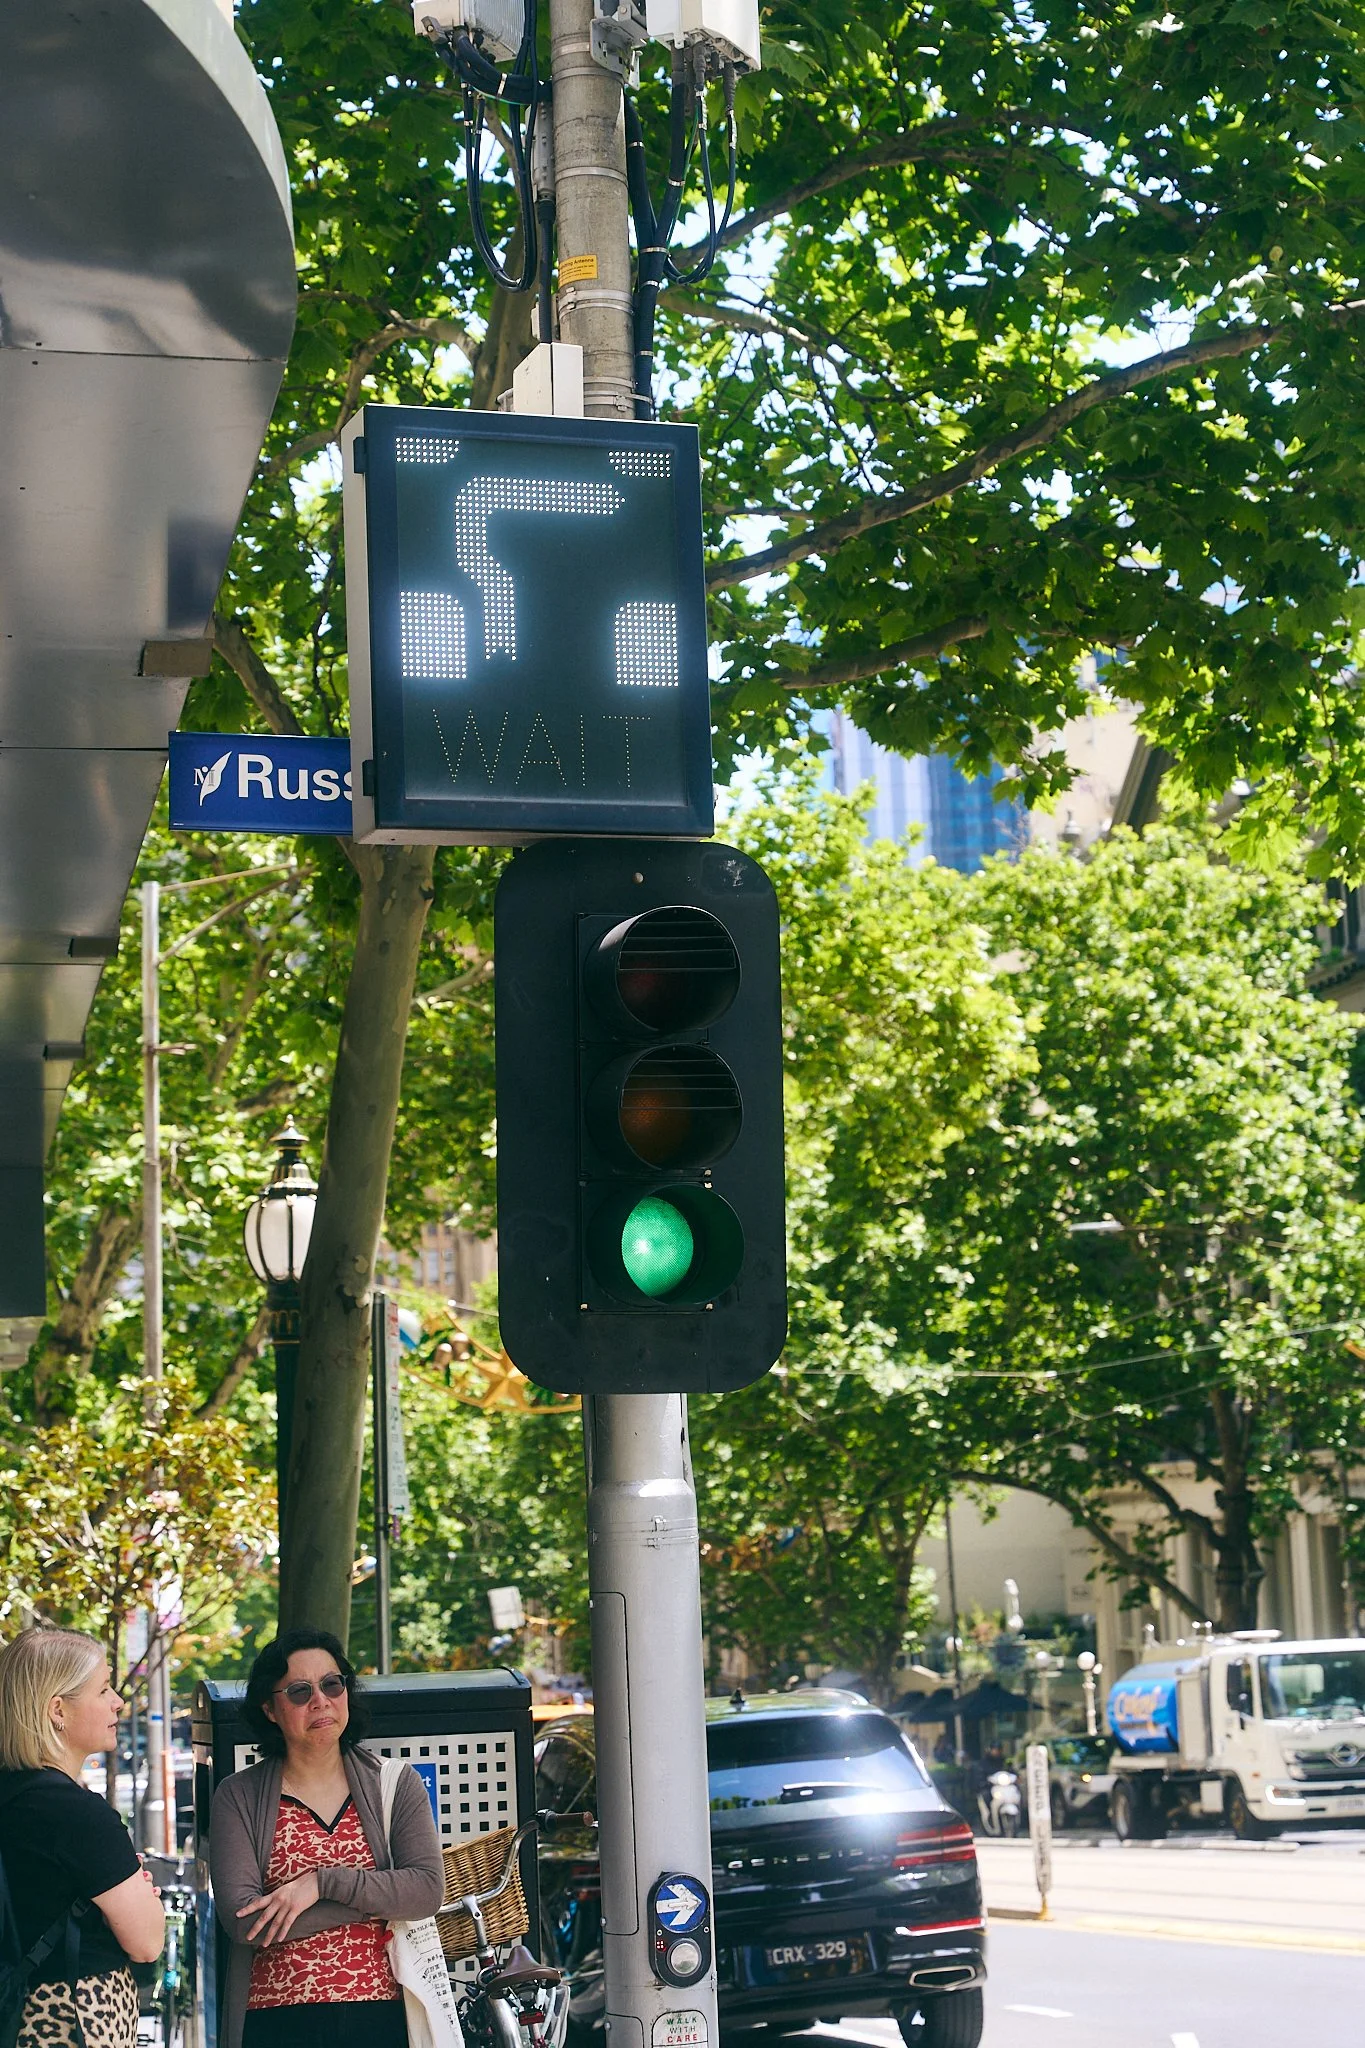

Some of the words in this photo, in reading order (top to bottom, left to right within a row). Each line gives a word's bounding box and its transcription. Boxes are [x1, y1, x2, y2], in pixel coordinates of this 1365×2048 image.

[433, 708, 651, 788] WAIT
[238, 753, 352, 801] Rus
[772, 1945, 806, 1965] CRX
[815, 1940, 847, 1960] 329
[667, 2016, 697, 2025] WALK
[667, 2033, 698, 2043] CARE
[669, 2026, 696, 2034] WITH
